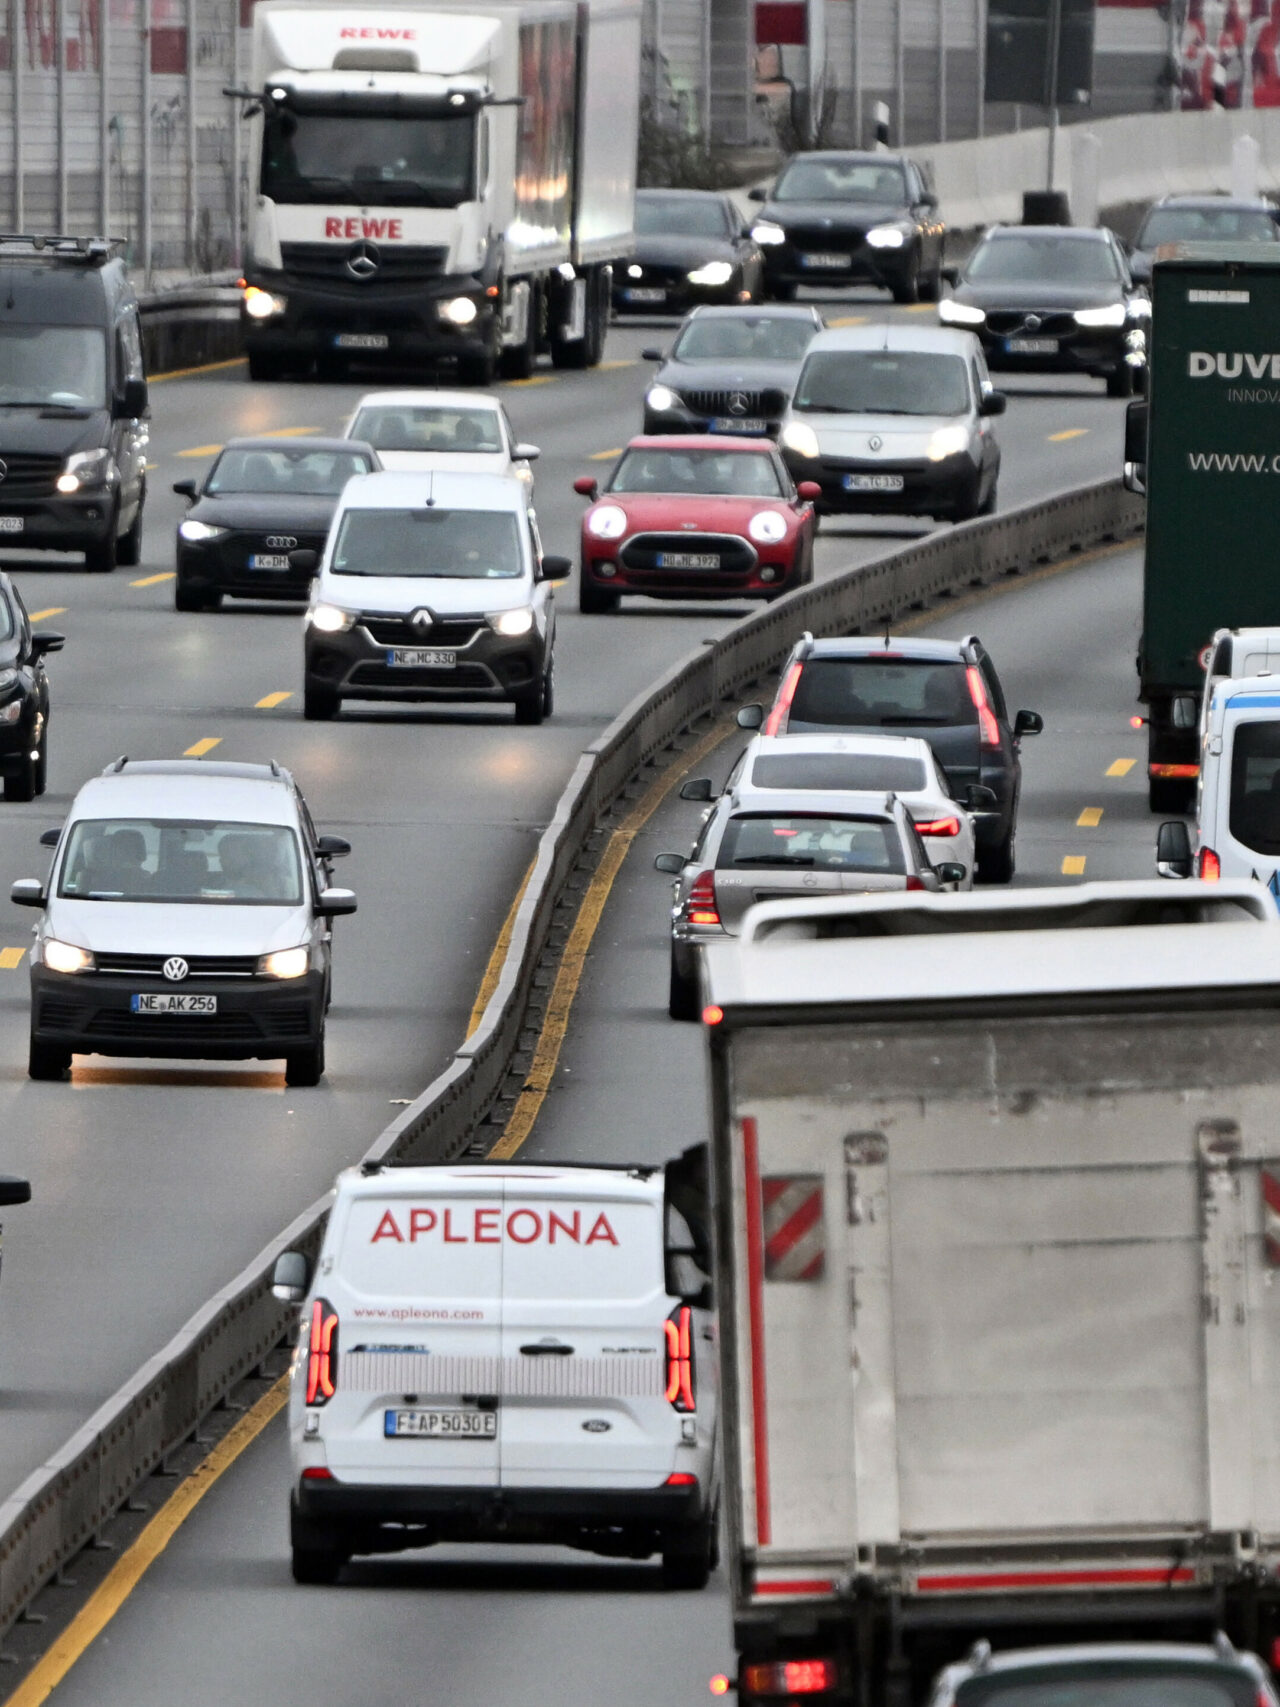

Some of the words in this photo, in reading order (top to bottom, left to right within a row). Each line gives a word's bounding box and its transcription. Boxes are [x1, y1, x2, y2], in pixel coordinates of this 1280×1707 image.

[340, 27, 417, 40] REWE
[325, 216, 403, 239] REWE
[394, 651, 409, 663] NE
[417, 653, 432, 664] MC
[434, 653, 455, 664] 330
[140, 995, 158, 1009] NE
[168, 996, 186, 1010] AK
[189, 997, 215, 1011] 256
[370, 1207, 619, 1246] APLEONA
[354, 1307, 484, 1321] www.apleona.com
[397, 1415, 407, 1430] F
[420, 1415, 438, 1431] AP
